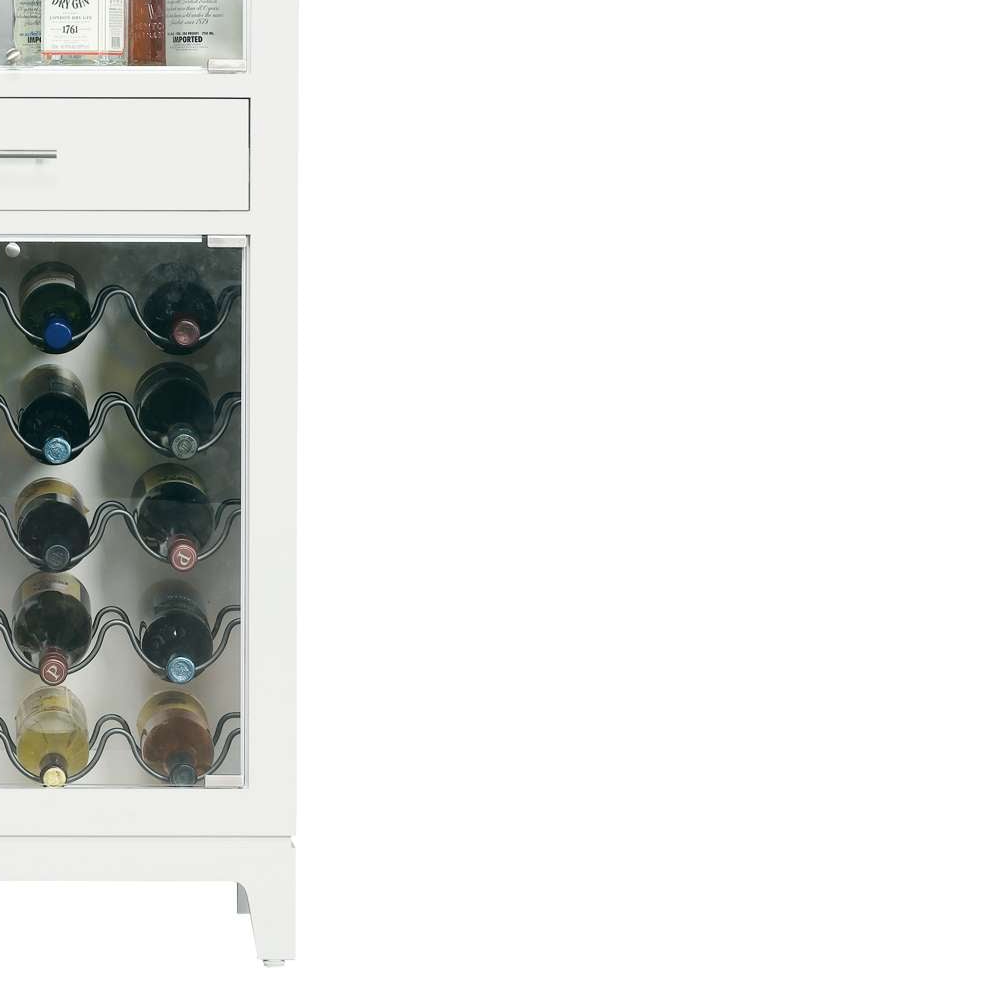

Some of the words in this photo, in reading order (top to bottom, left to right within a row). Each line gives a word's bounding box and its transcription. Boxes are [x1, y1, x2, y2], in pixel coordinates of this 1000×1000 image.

[62, 24, 79, 34] 1761
[178, 551, 192, 566] P
[46, 664, 60, 681] P
